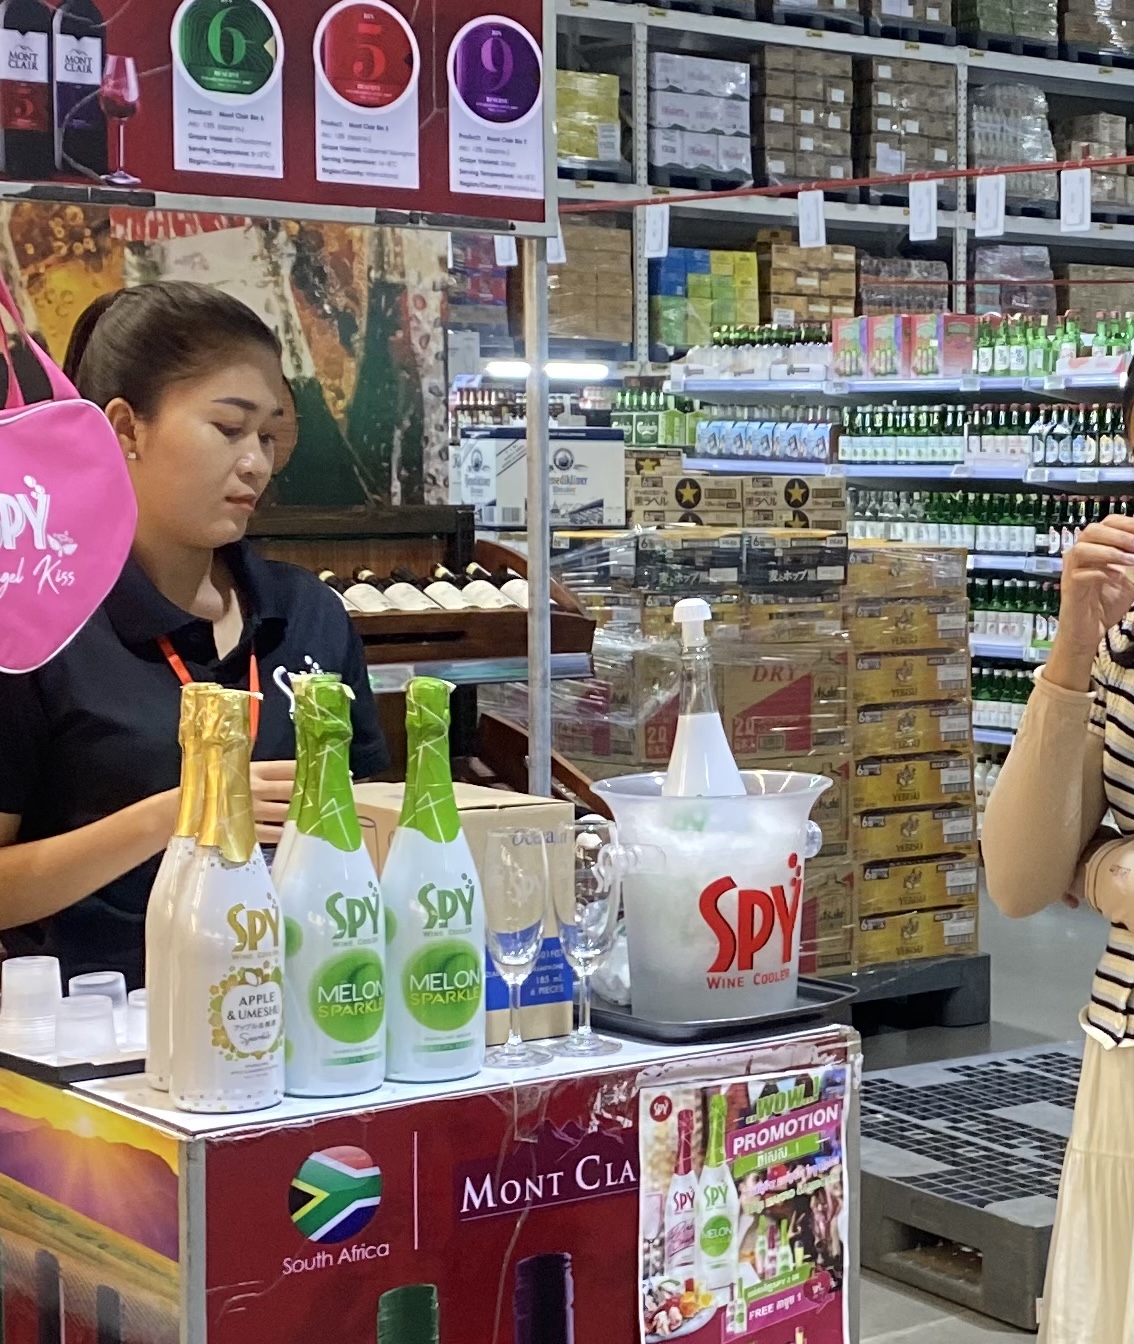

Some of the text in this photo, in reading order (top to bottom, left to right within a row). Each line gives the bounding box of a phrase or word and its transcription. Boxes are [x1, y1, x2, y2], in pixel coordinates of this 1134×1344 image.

[208, 6, 247, 66] 6
[8, 51, 38, 62] MONT
[64, 55, 92, 65] MONT
[353, 23, 386, 81] 5
[8, 59, 38, 70] CLAIR
[64, 63, 92, 73] CLAIR
[481, 37, 513, 92] 9
[0, 492, 50, 550] PY
[0, 554, 75, 599] gel Kiss
[752, 664, 798, 682] DRY
[325, 892, 380, 940] SPY
[418, 883, 475, 930] SPY
[227, 903, 279, 953] SPY
[699, 876, 803, 973] SPY
[318, 980, 384, 1003] MELON
[409, 968, 481, 991] MELON
[706, 968, 790, 991] WINE COOLER
[239, 992, 276, 1007] APPLE
[410, 986, 480, 1006] SPARKLE
[227, 1010, 236, 1020] &
[733, 1104, 839, 1156] PROMOTION
[460, 1155, 637, 1213] MONT CLA
[673, 1190, 695, 1212] SPY
[704, 1184, 729, 1209] SPY
[282, 1241, 390, 1276] South Africa
[749, 1303, 775, 1321] FREE
